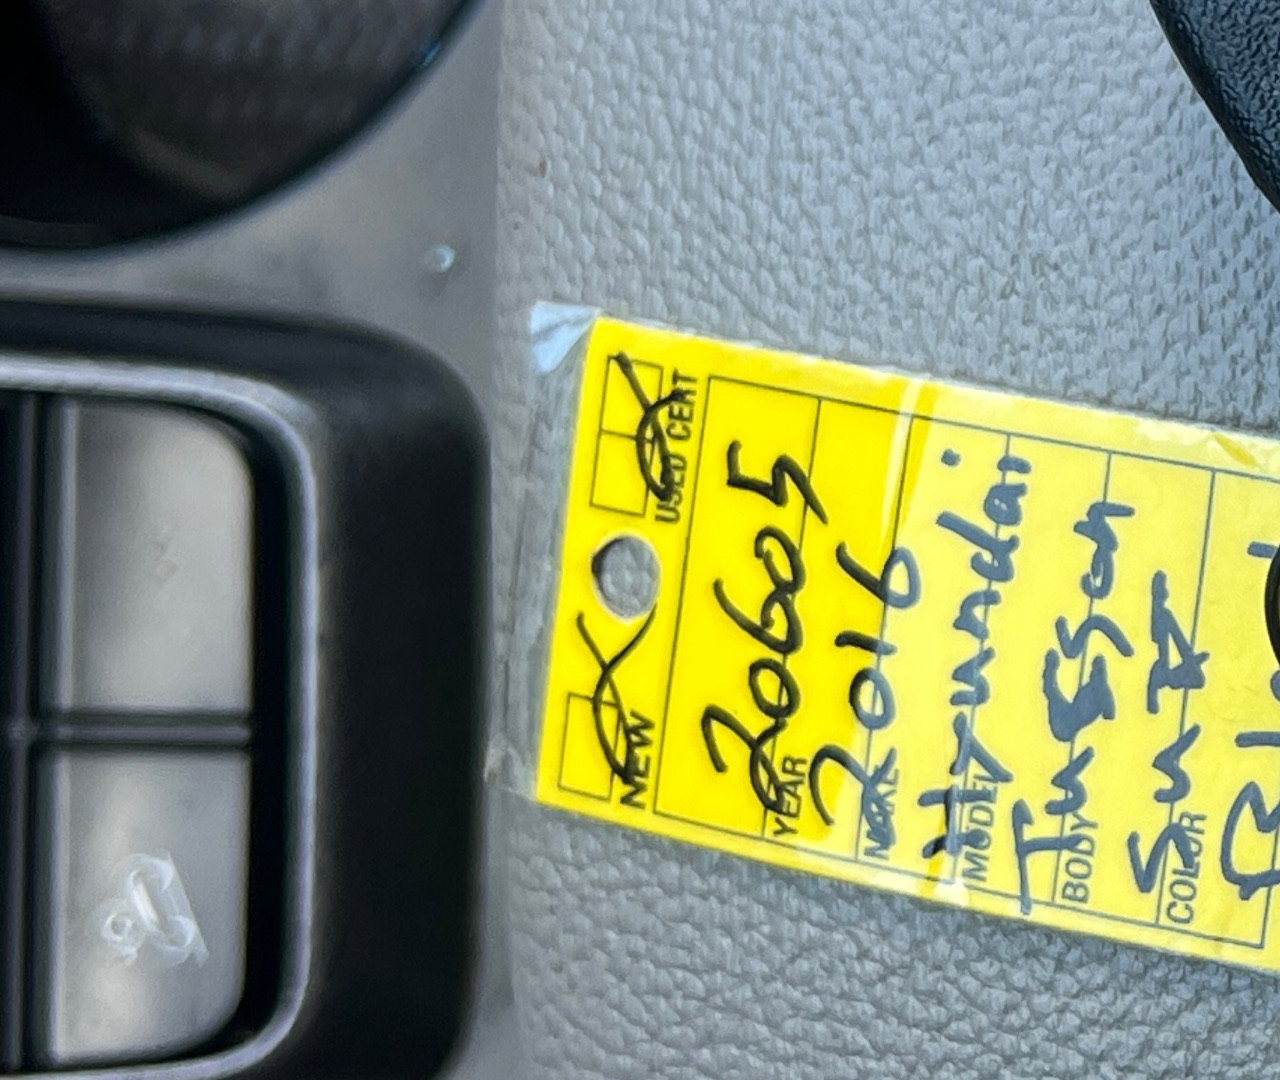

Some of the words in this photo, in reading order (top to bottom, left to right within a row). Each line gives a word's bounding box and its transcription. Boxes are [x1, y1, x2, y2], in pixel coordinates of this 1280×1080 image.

[700, 438, 829, 816] 20605
[809, 540, 922, 846] 2016
[620, 709, 655, 810] NEW
[773, 756, 807, 838] YEAR
[865, 763, 900, 860] MKE
[1061, 811, 1099, 904] BODY
[1166, 811, 1208, 925] COLOR
